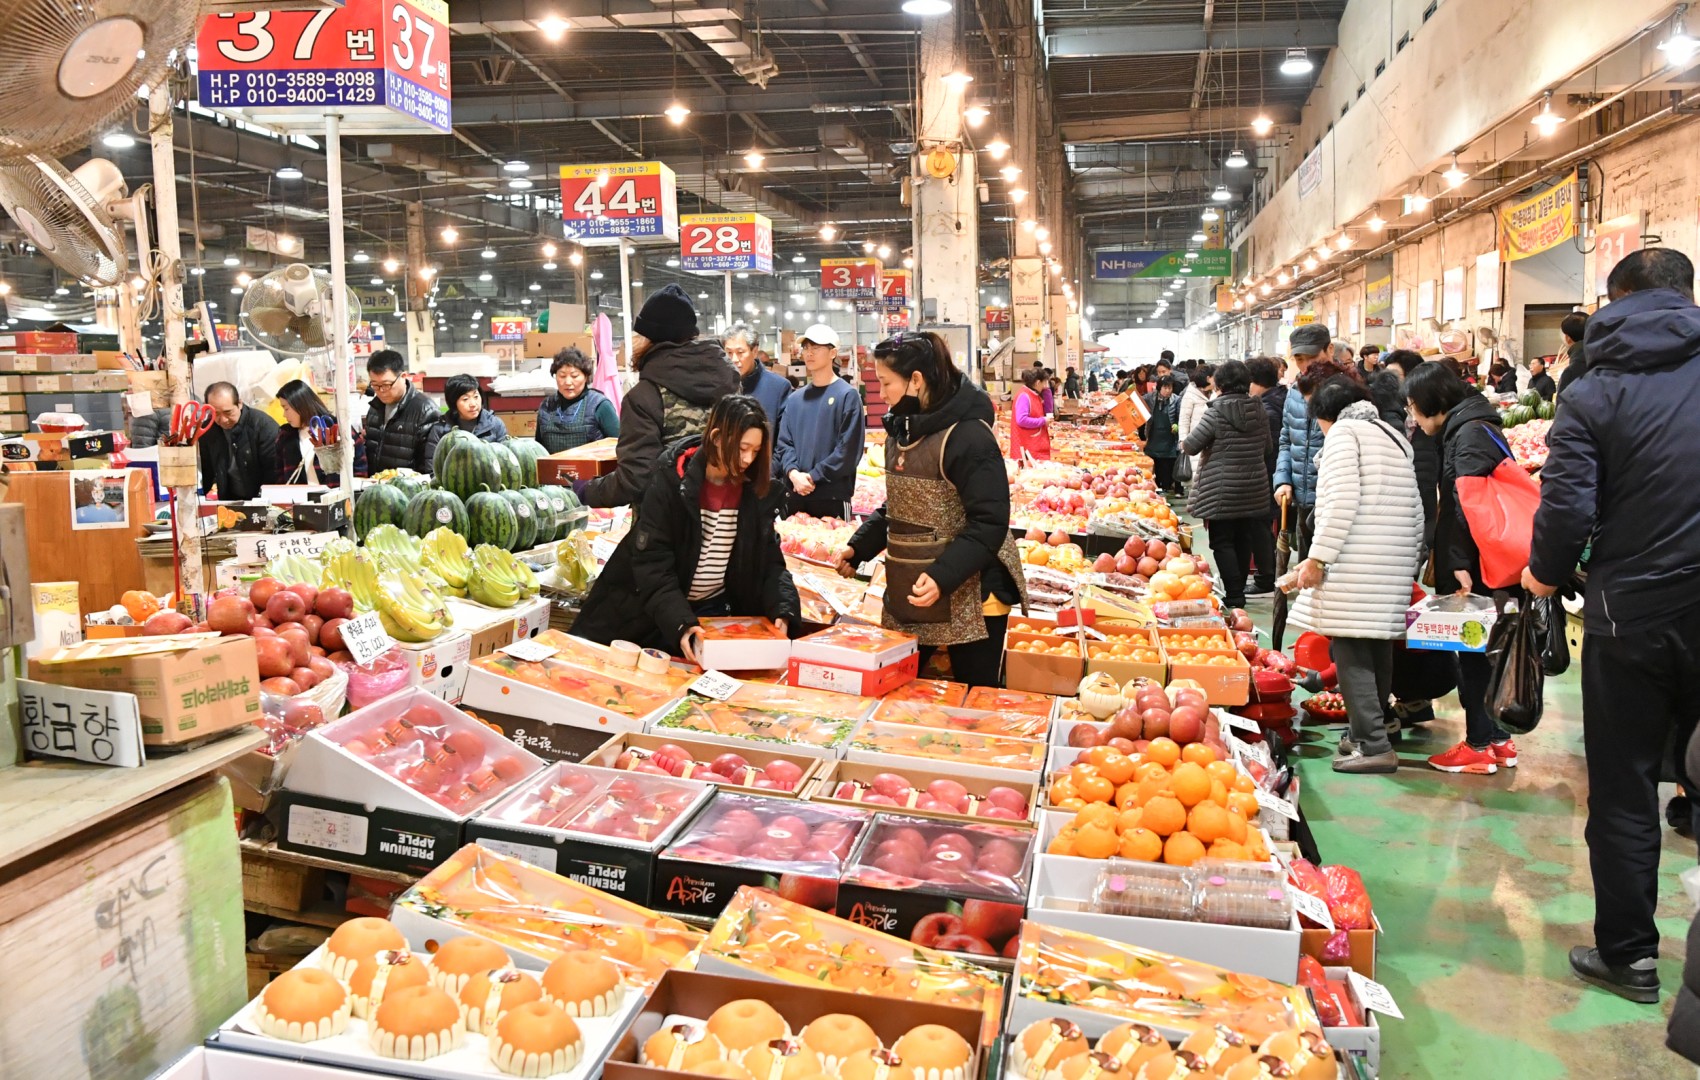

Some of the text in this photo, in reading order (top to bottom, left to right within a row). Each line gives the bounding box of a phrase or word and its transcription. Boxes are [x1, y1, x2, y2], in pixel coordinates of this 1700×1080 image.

[210, 72, 375, 88] H.P 010-3589-8098
[211, 88, 376, 104] H.P 010-9400-1429
[571, 220, 586, 228] H.P
[1101, 260, 1145, 270] NH Bank
[1365, 317, 1384, 326] Dole
[181, 675, 250, 710] 후레쉬라이프
[23, 694, 120, 761] 황금향
[398, 833, 436, 849] APPLE
[380, 841, 435, 861] PREMIUM
[588, 864, 628, 880] APPLE
[683, 875, 716, 888] Premium
[864, 901, 897, 914] Premium
